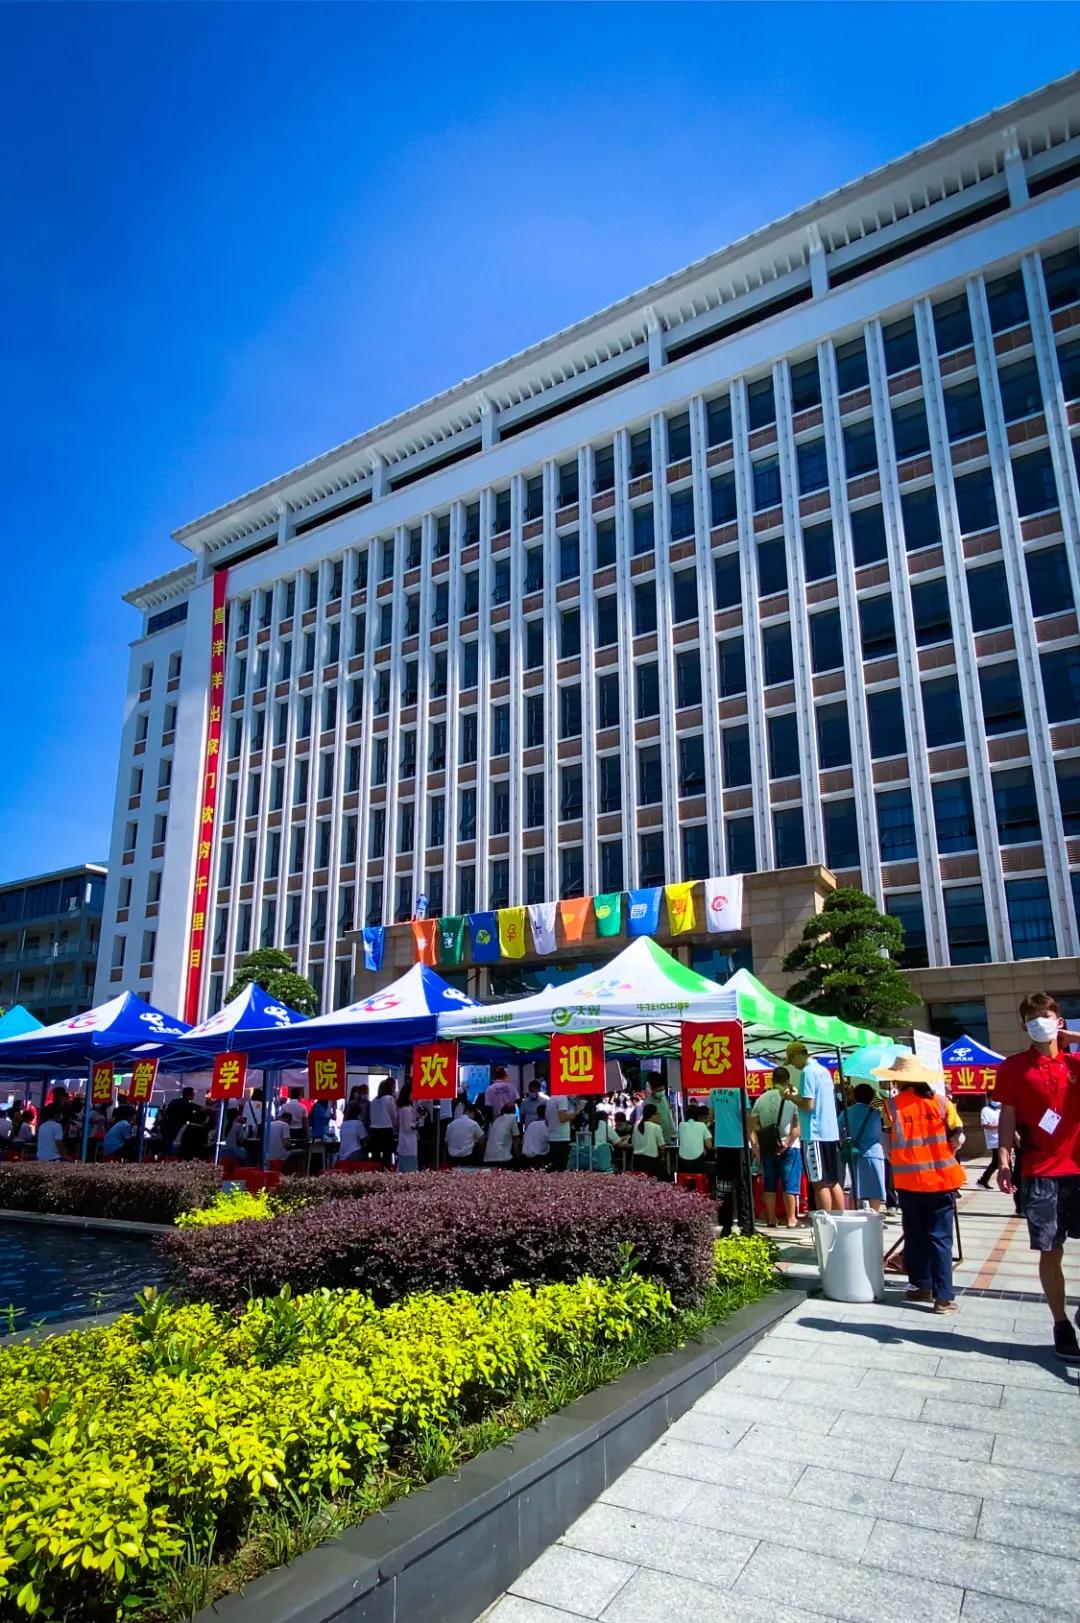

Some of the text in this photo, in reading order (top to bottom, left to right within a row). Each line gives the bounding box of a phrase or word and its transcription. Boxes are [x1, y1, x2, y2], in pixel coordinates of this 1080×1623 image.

[420, 1053, 449, 1088] 欢
[558, 1044, 594, 1083] 迎
[691, 1031, 732, 1075] 您
[94, 1068, 111, 1099] 经
[133, 1063, 155, 1098] 管
[219, 1060, 240, 1090] 学
[314, 1059, 338, 1091] 院
